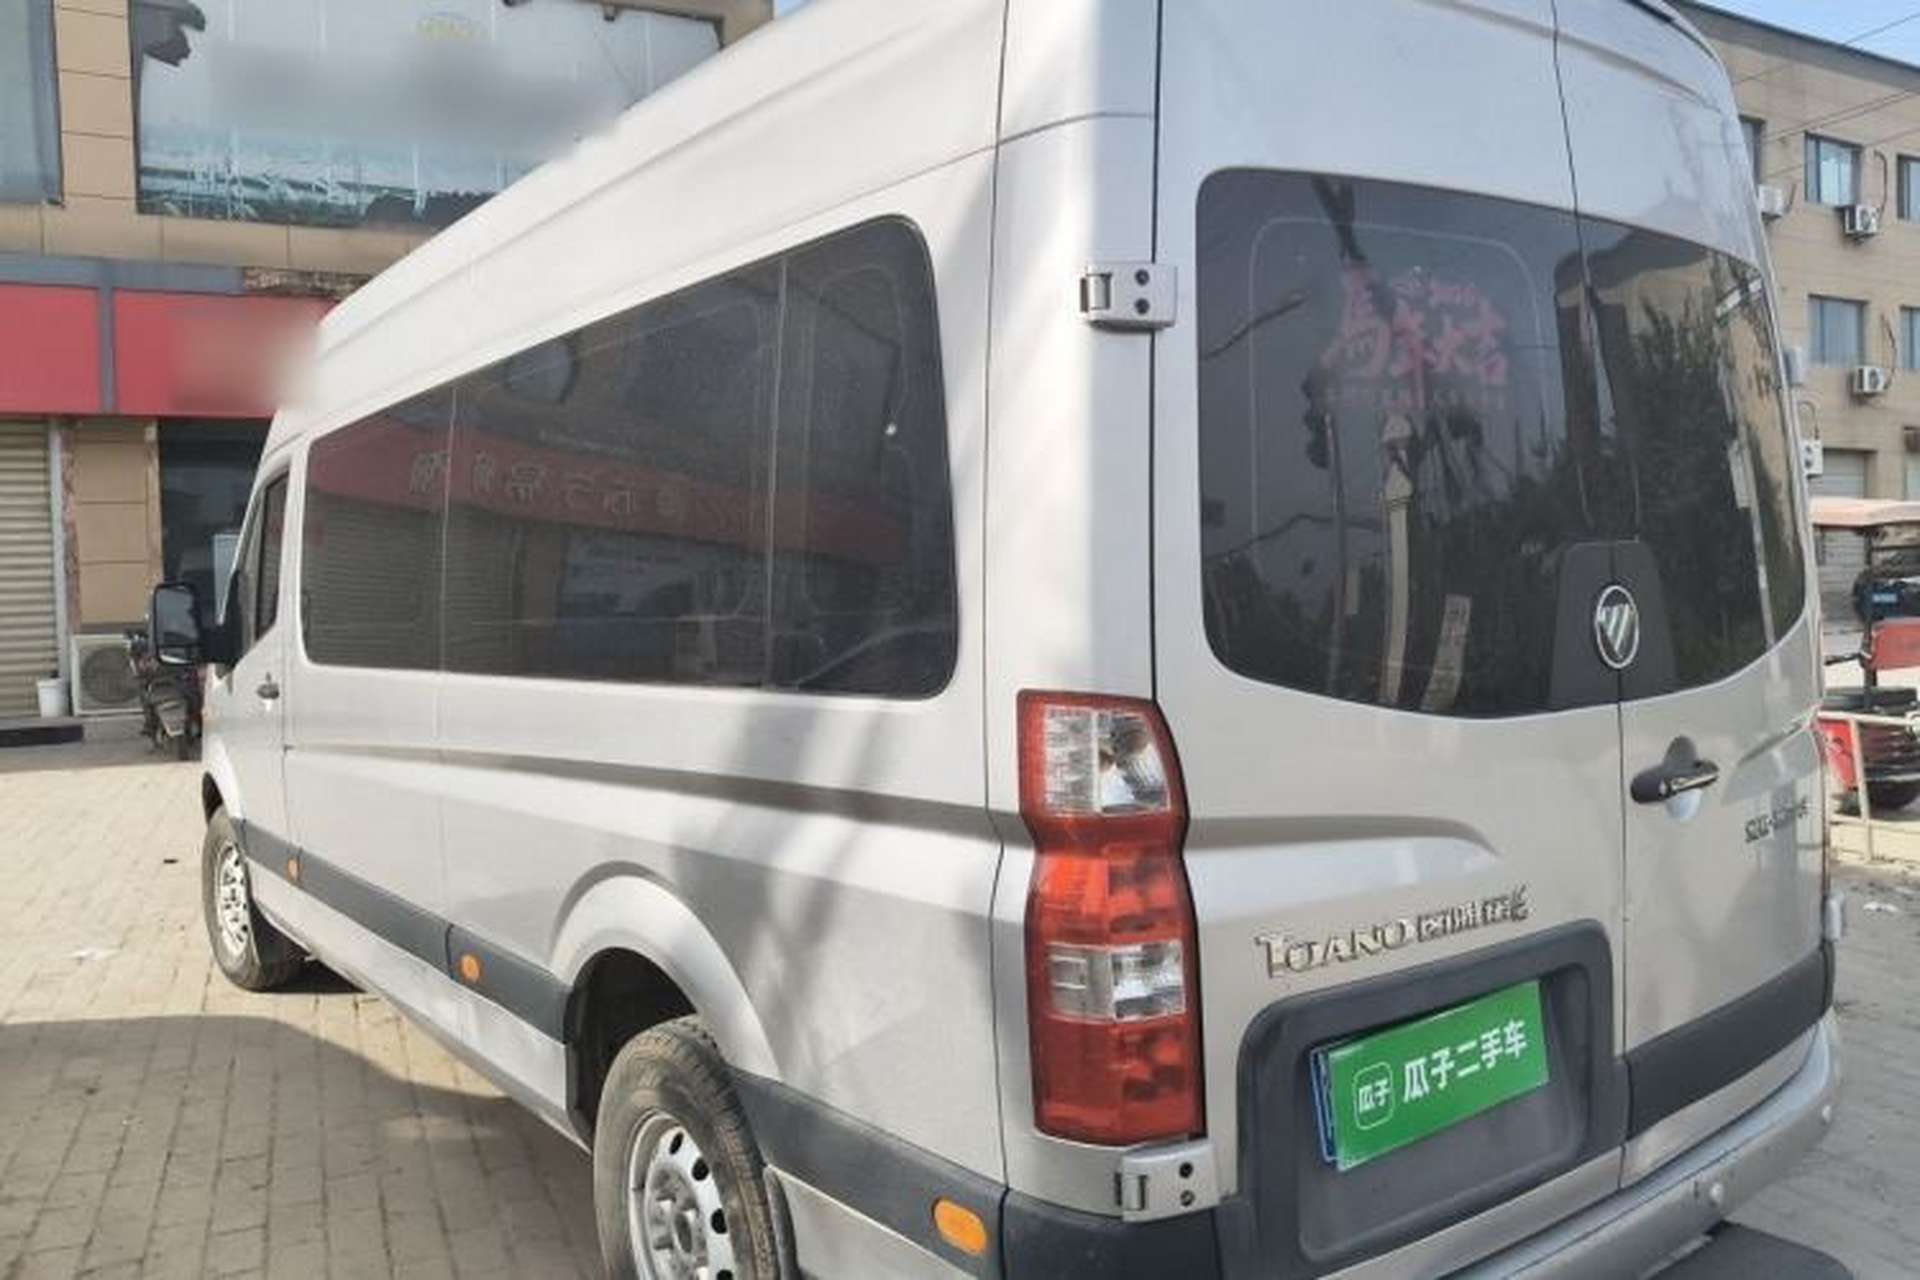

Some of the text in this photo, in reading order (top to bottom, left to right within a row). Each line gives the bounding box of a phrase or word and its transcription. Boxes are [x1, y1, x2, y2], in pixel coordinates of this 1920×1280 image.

[1254, 918, 1413, 979] TOANO
[1358, 1018, 1528, 1114] 瓜子 瓜子二手车
